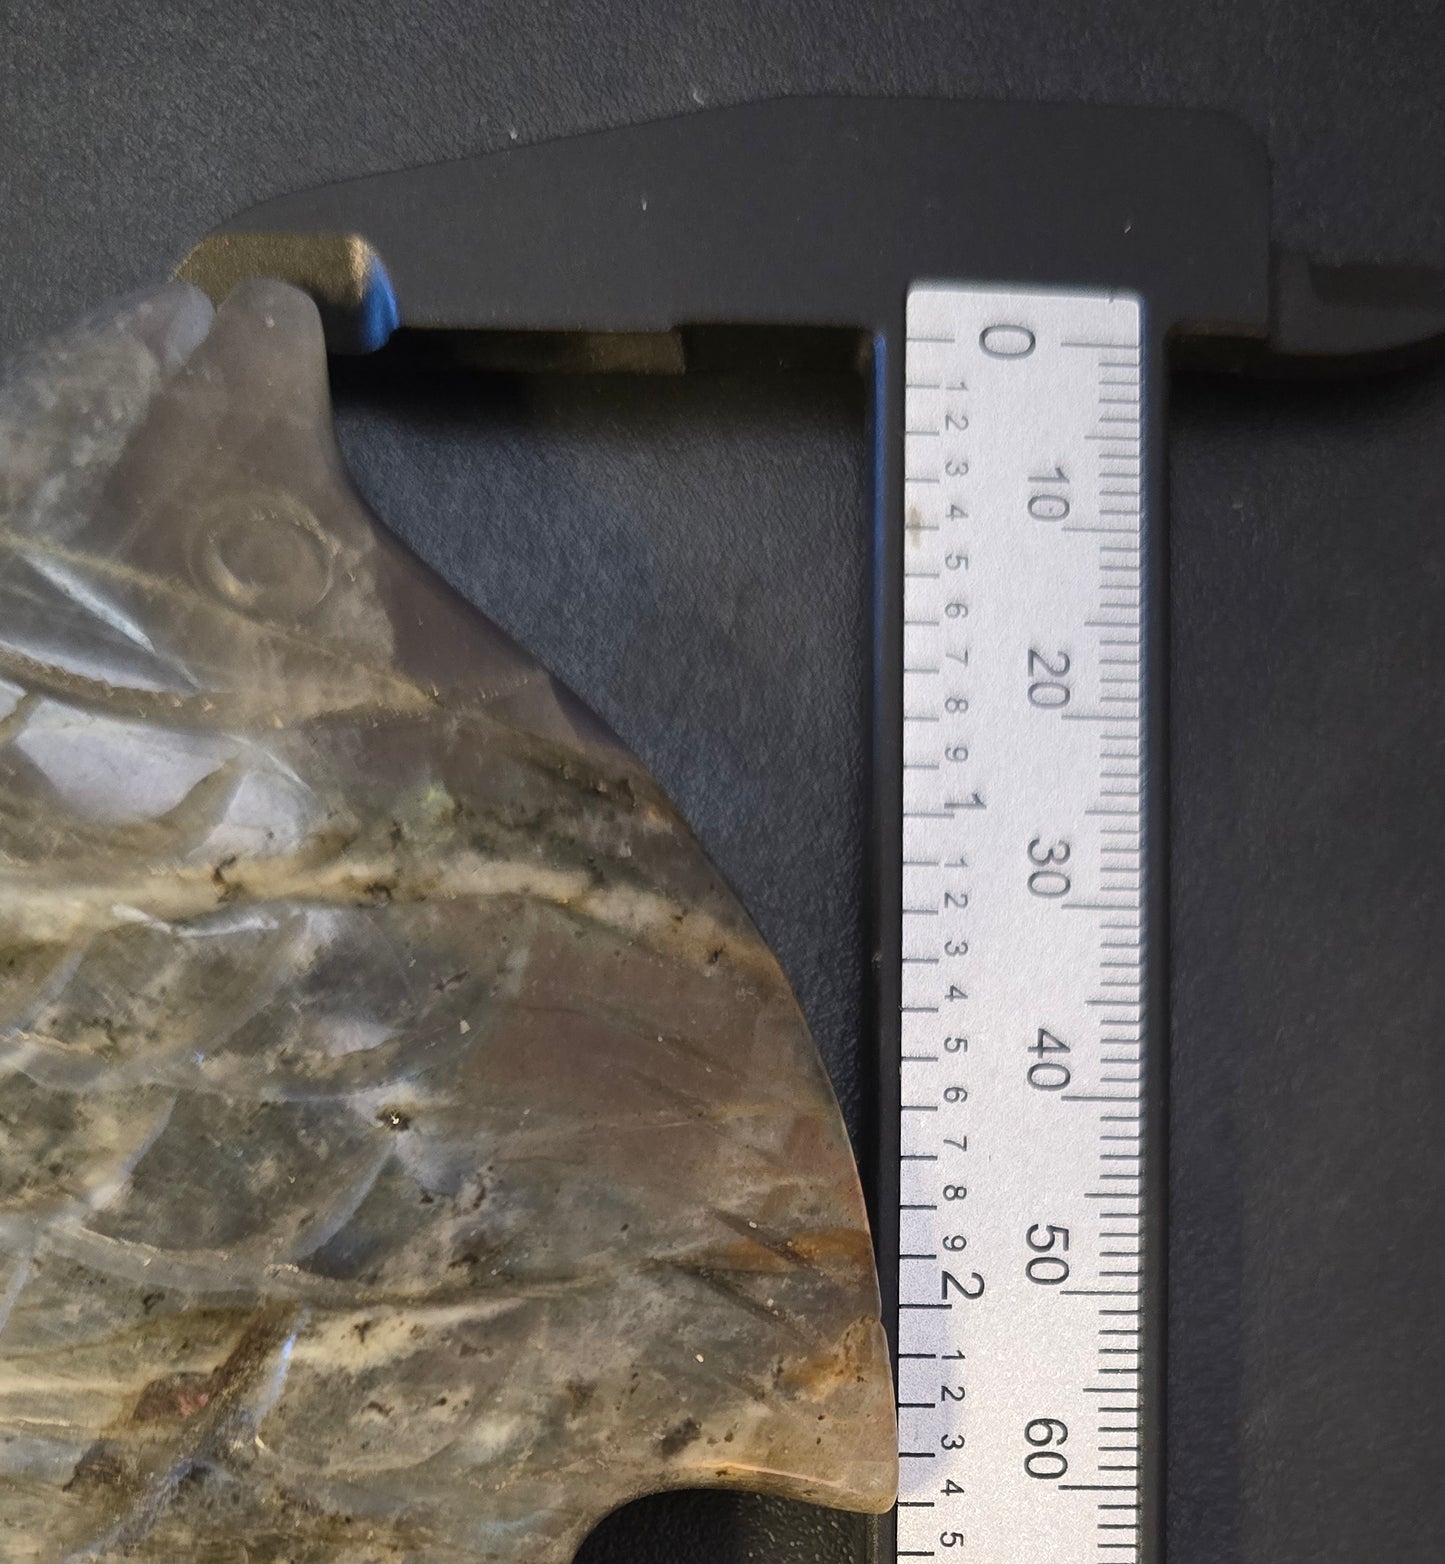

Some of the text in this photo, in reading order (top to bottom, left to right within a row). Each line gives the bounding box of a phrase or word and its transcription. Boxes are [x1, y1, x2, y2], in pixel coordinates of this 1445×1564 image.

[978, 323, 1037, 359] 0
[944, 413, 969, 431] 2
[944, 459, 970, 477] 3
[1027, 466, 1071, 521] 10
[945, 503, 969, 521] 4
[944, 553, 969, 570] 5
[944, 599, 969, 618] 6
[945, 646, 969, 667] 7
[1027, 647, 1071, 707] 20
[944, 696, 969, 714] 8
[944, 746, 969, 761] 9
[1027, 837, 1072, 897] 30
[944, 891, 969, 908] 2
[944, 939, 969, 957] 3
[944, 984, 969, 1002] 4
[943, 1036, 968, 1053] 5
[1026, 1027, 1071, 1091] 40
[943, 1086, 968, 1104] 6
[943, 1135, 968, 1152] 7
[942, 1184, 968, 1202] 8
[942, 1234, 968, 1252] 9
[1025, 1223, 1070, 1286] 50
[941, 1270, 985, 1300] 2
[940, 1385, 966, 1402] 2
[940, 1433, 966, 1451] 3
[1024, 1417, 1069, 1480] 60
[940, 1478, 965, 1497] 4
[939, 1531, 964, 1548] 5
